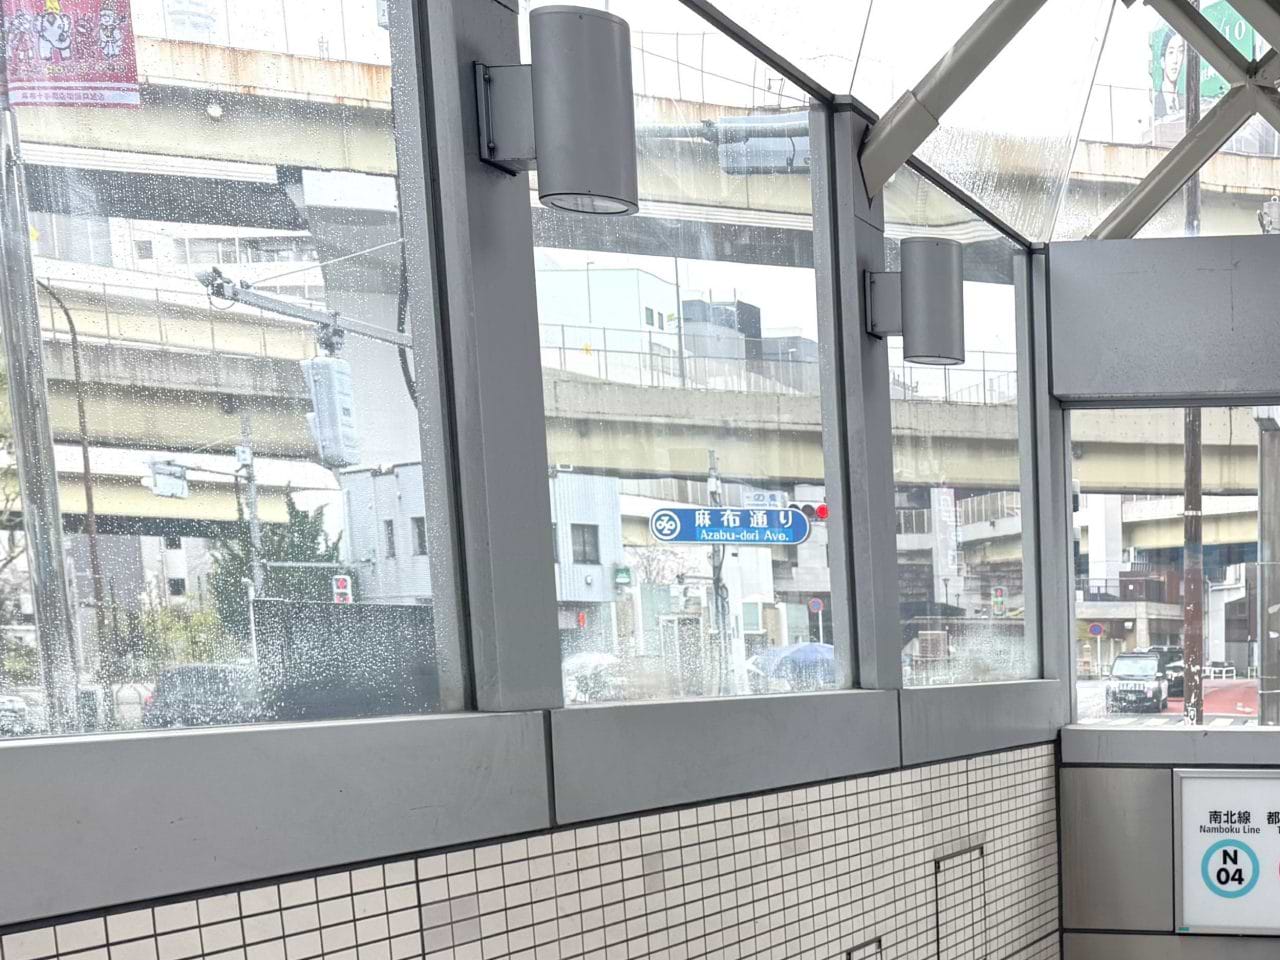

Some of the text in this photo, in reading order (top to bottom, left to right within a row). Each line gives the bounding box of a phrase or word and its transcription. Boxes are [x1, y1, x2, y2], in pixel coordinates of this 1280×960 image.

[695, 510, 793, 528] 麻布通り
[700, 530, 789, 541] Azabu-dori Ave.
[1208, 810, 1251, 824] 南北線
[1199, 825, 1261, 834] Namboku Line
[1222, 850, 1239, 865] N
[1216, 869, 1245, 886] 04
